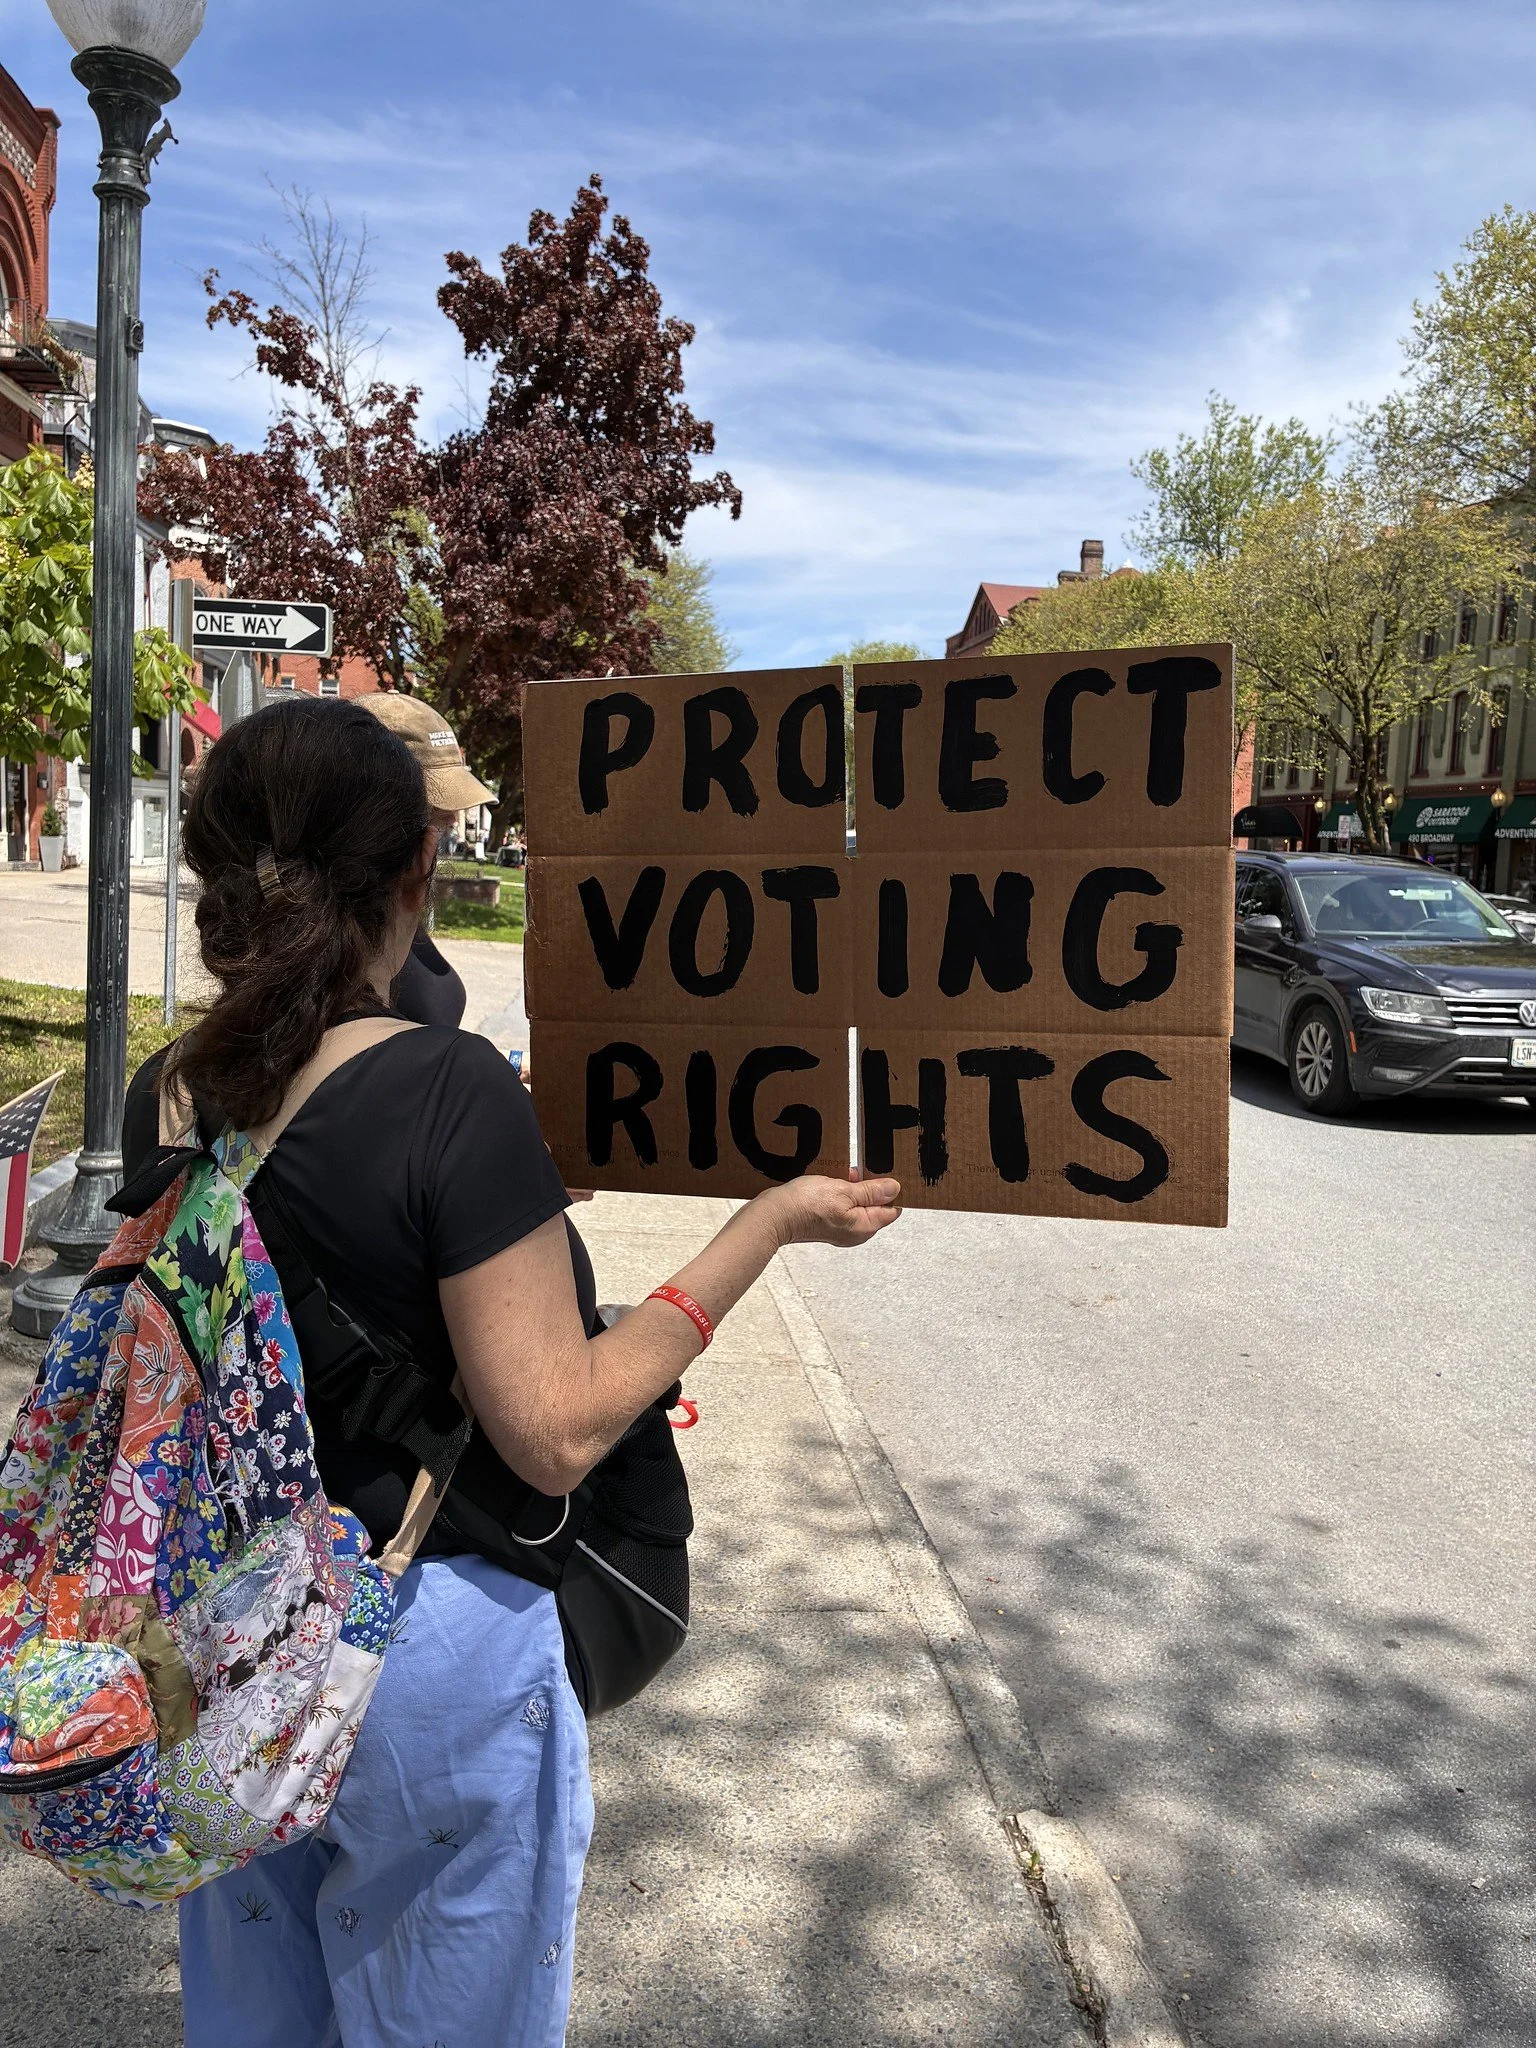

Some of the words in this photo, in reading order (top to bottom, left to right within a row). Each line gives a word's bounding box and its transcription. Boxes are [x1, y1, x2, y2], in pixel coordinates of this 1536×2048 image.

[196, 614, 235, 633] ONE
[242, 616, 282, 635] WAY
[578, 656, 1223, 818] PROTECT
[1433, 806, 1470, 817] SARATOGA
[1421, 833, 1454, 843] BROADWAY
[578, 865, 1185, 1012] VOTING
[585, 1041, 1175, 1204] RIGHTS
[683, 1297, 709, 1327] Trust
